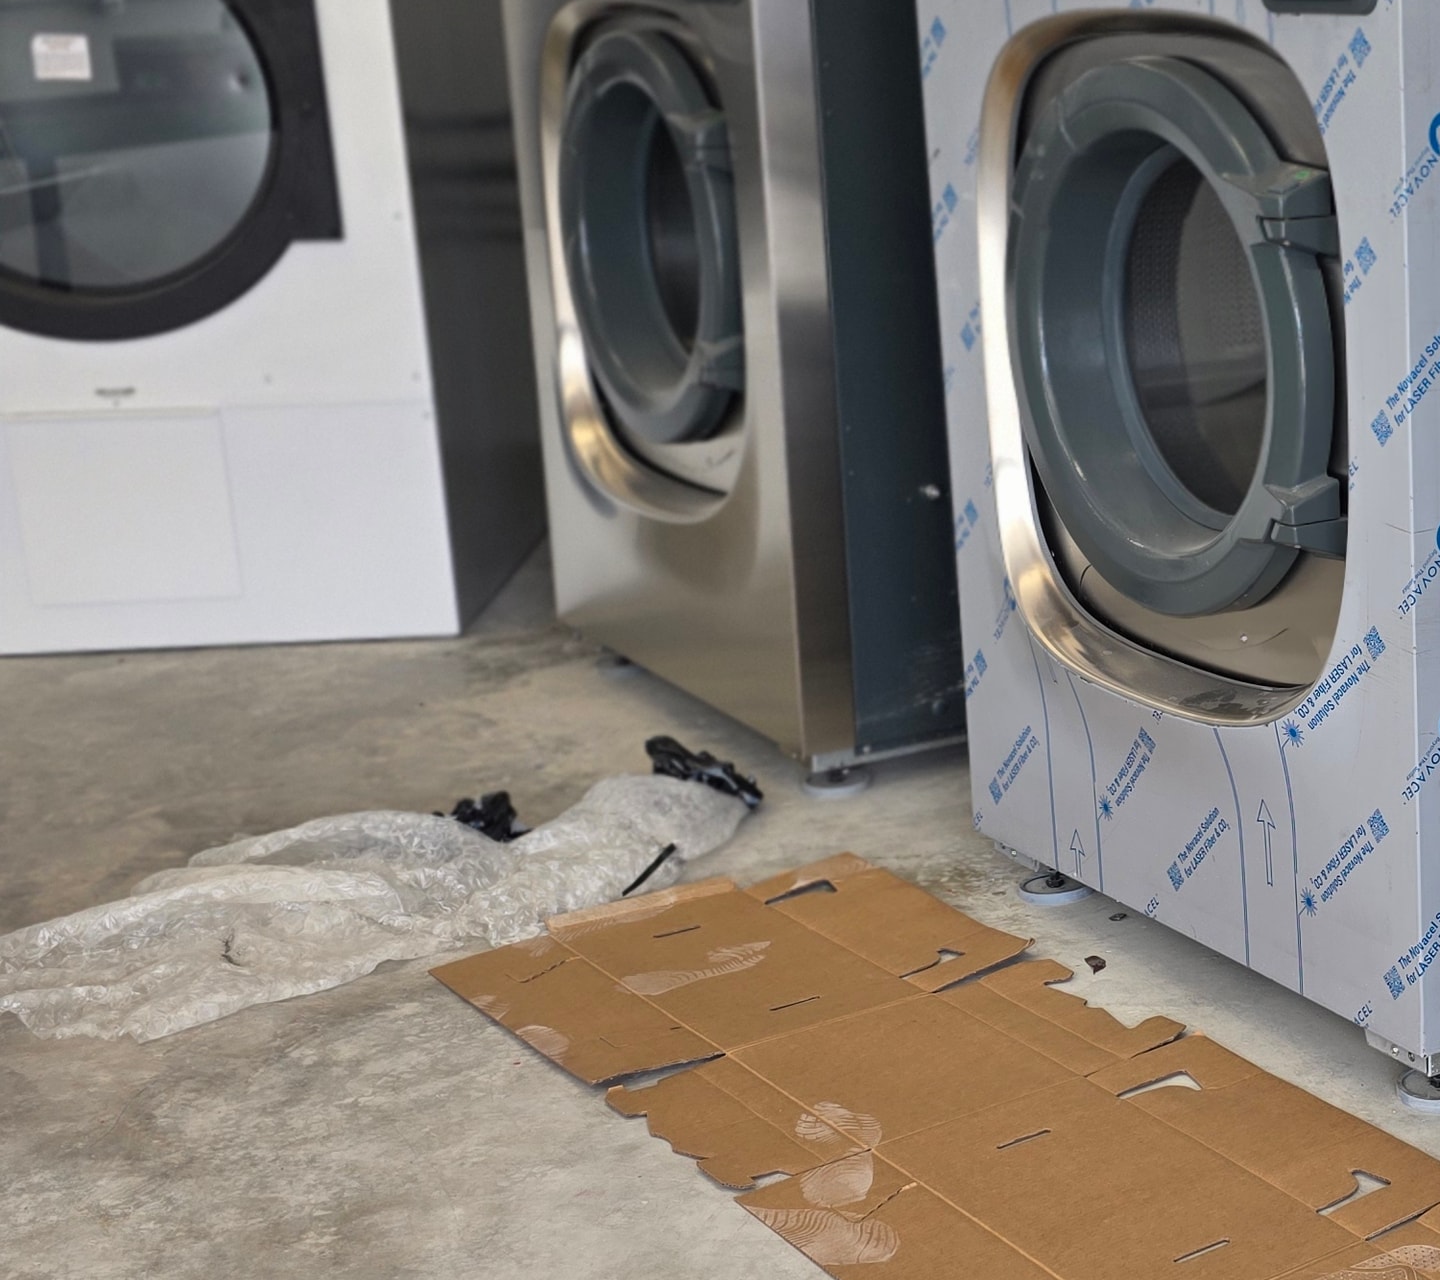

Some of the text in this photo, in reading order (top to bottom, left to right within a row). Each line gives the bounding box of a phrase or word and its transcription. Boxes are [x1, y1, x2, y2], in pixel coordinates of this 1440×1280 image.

[1386, 392, 1400, 410] The
[1397, 354, 1428, 395] Novacel
[1394, 410, 1406, 427] for
[1403, 377, 1432, 413] LASER
[1350, 644, 1362, 658] for
[1328, 655, 1352, 683] LASER
[1307, 697, 1315, 707] &
[1308, 660, 1371, 730] The Novacel Solution
[1313, 679, 1331, 700] Fiber
[1356, 825, 1366, 838] for
[1191, 847, 1207, 870] LASER
[1338, 834, 1358, 860] LASER
[1321, 841, 1374, 902] The Novacel Solution
[1321, 869, 1327, 880] &
[1326, 855, 1340, 873] Fiber
[1398, 953, 1412, 969] The
[1409, 921, 1438, 959] Novacel
[1406, 973, 1416, 986] for
[1415, 942, 1440, 977] LASER
